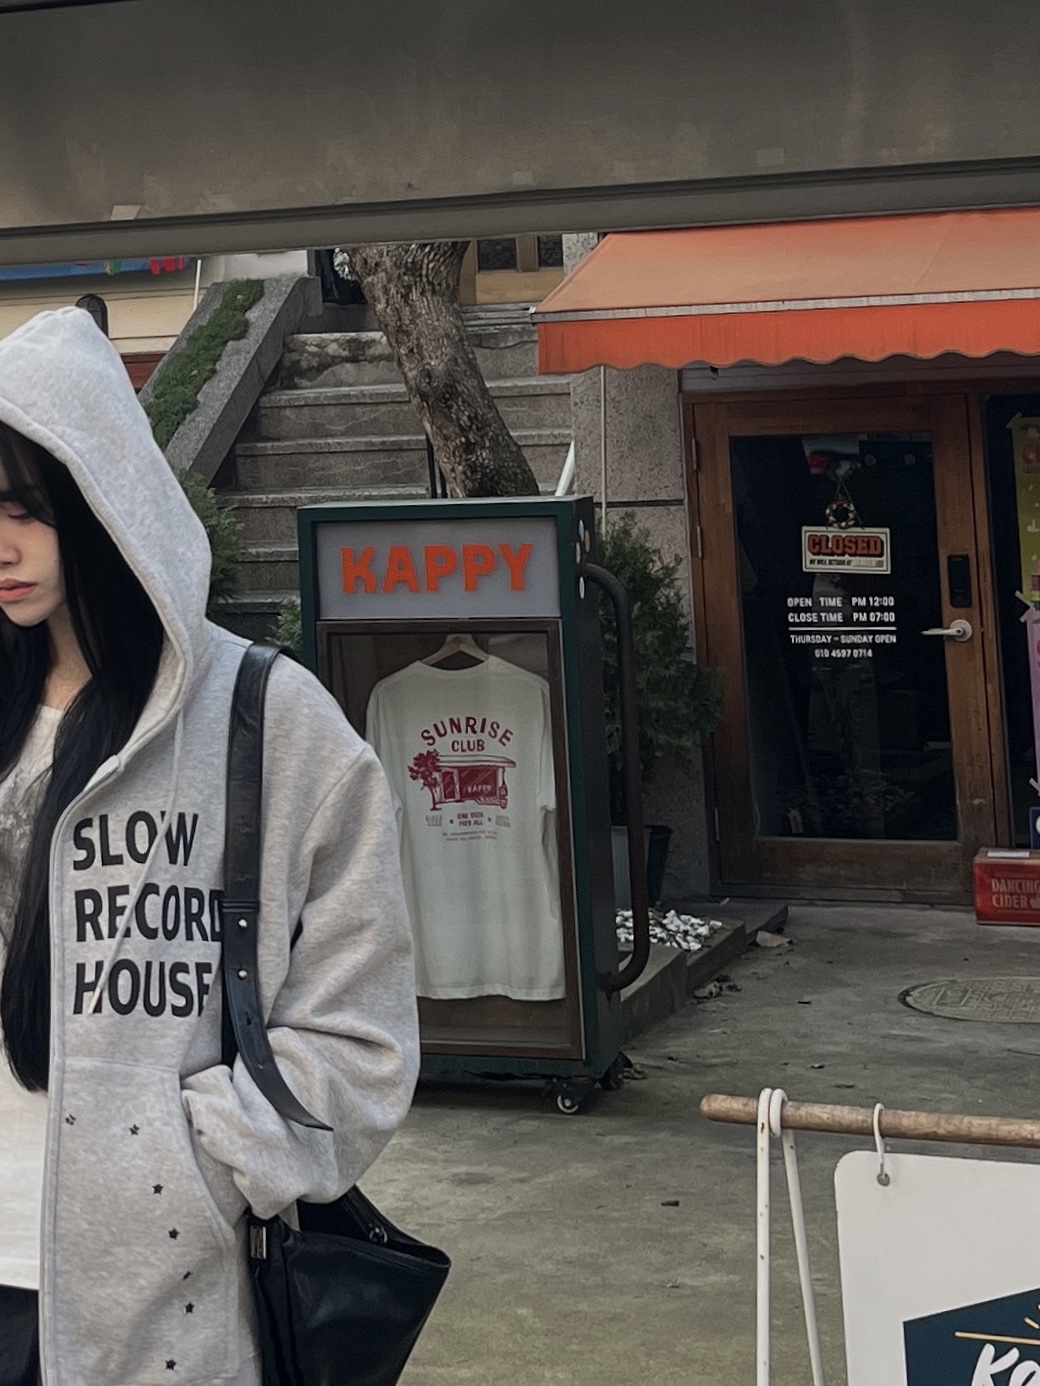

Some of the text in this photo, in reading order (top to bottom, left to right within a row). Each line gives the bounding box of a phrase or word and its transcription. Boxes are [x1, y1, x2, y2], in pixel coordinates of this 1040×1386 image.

[808, 534, 884, 557] CLOSED
[341, 543, 534, 593] KAPPY
[787, 596, 894, 607] OPEN TIME PM 12:00
[788, 612, 895, 622] CLOSE TIME PM 07:00
[790, 635, 832, 644] THURSDAY
[840, 635, 873, 643] SUNDAY
[875, 634, 897, 643] OPEN
[815, 649, 829, 658] 010
[421, 716, 513, 746] SUNRISE
[451, 739, 485, 752] CLUB
[73, 810, 199, 871] SLOW
[992, 894, 1028, 908] CIDER
